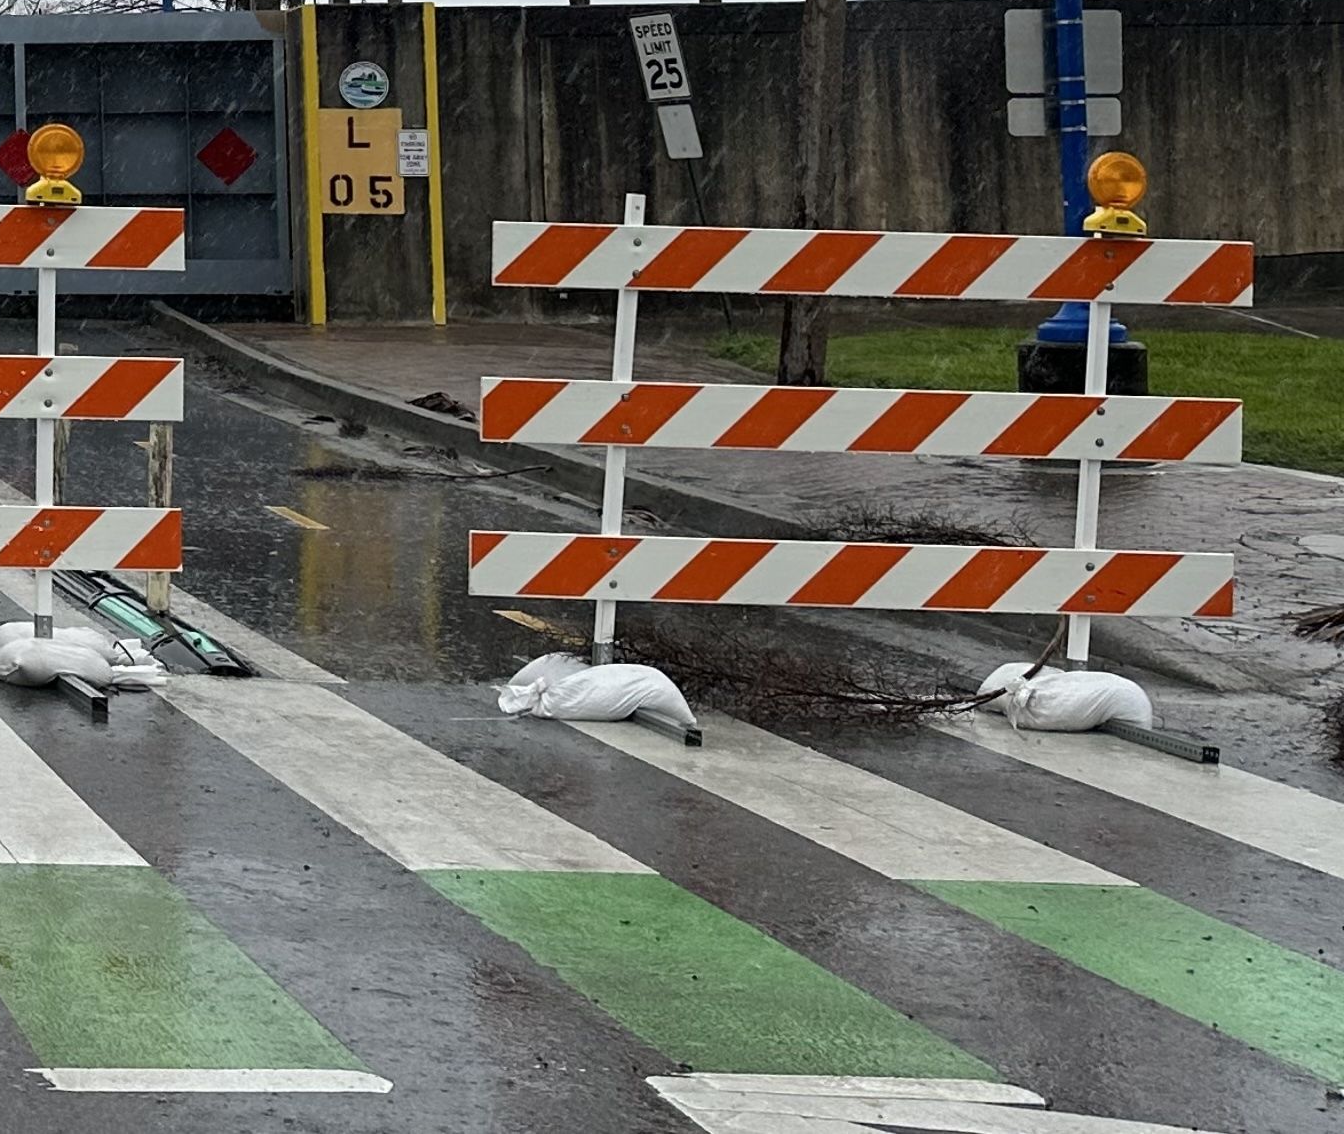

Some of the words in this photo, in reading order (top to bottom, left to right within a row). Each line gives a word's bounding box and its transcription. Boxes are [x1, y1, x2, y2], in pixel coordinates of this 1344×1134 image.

[634, 22, 672, 39] SPEED
[643, 40, 672, 56] LIMIT
[645, 57, 683, 90] 25
[347, 116, 370, 148] L
